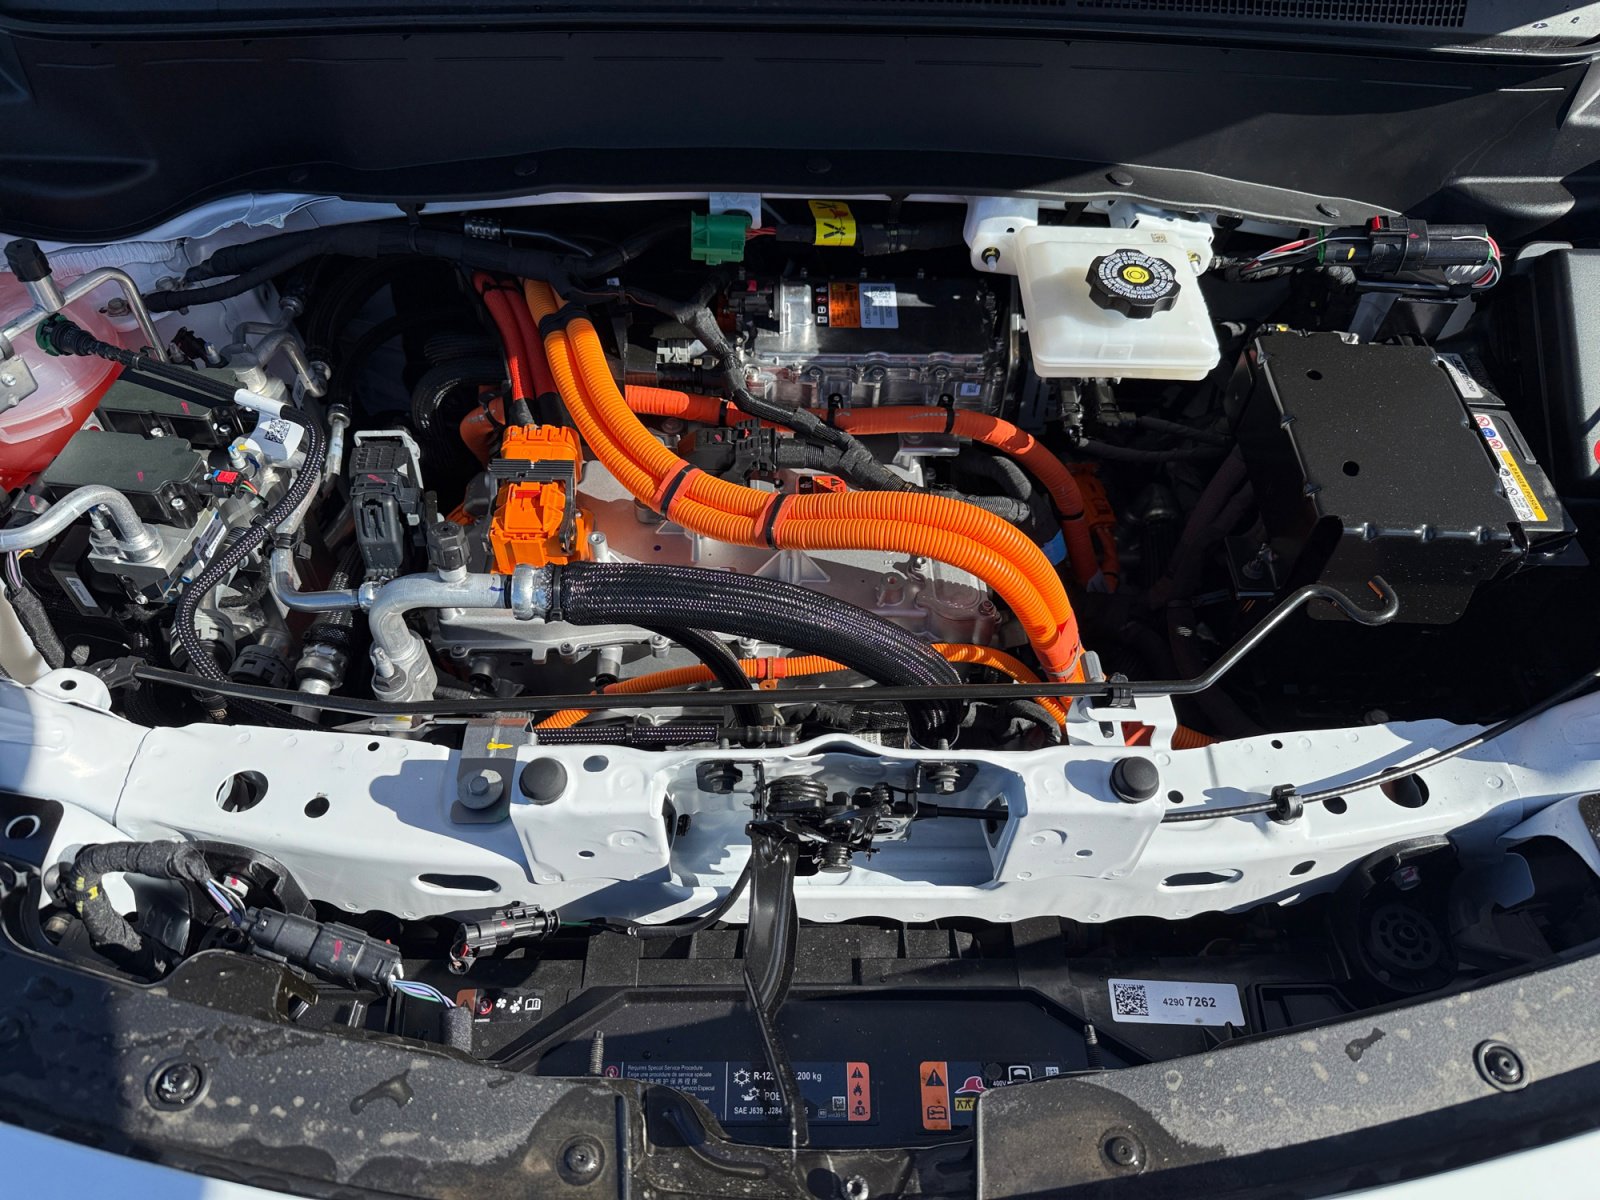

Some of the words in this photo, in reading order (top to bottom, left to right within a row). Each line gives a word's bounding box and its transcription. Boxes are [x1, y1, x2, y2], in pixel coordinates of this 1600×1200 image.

[1162, 998, 1185, 1006] 4290
[1185, 996, 1217, 1008] 7262
[812, 1071, 822, 1082] kg
[734, 1106, 748, 1114] SAE
[767, 1106, 783, 1114] J284
